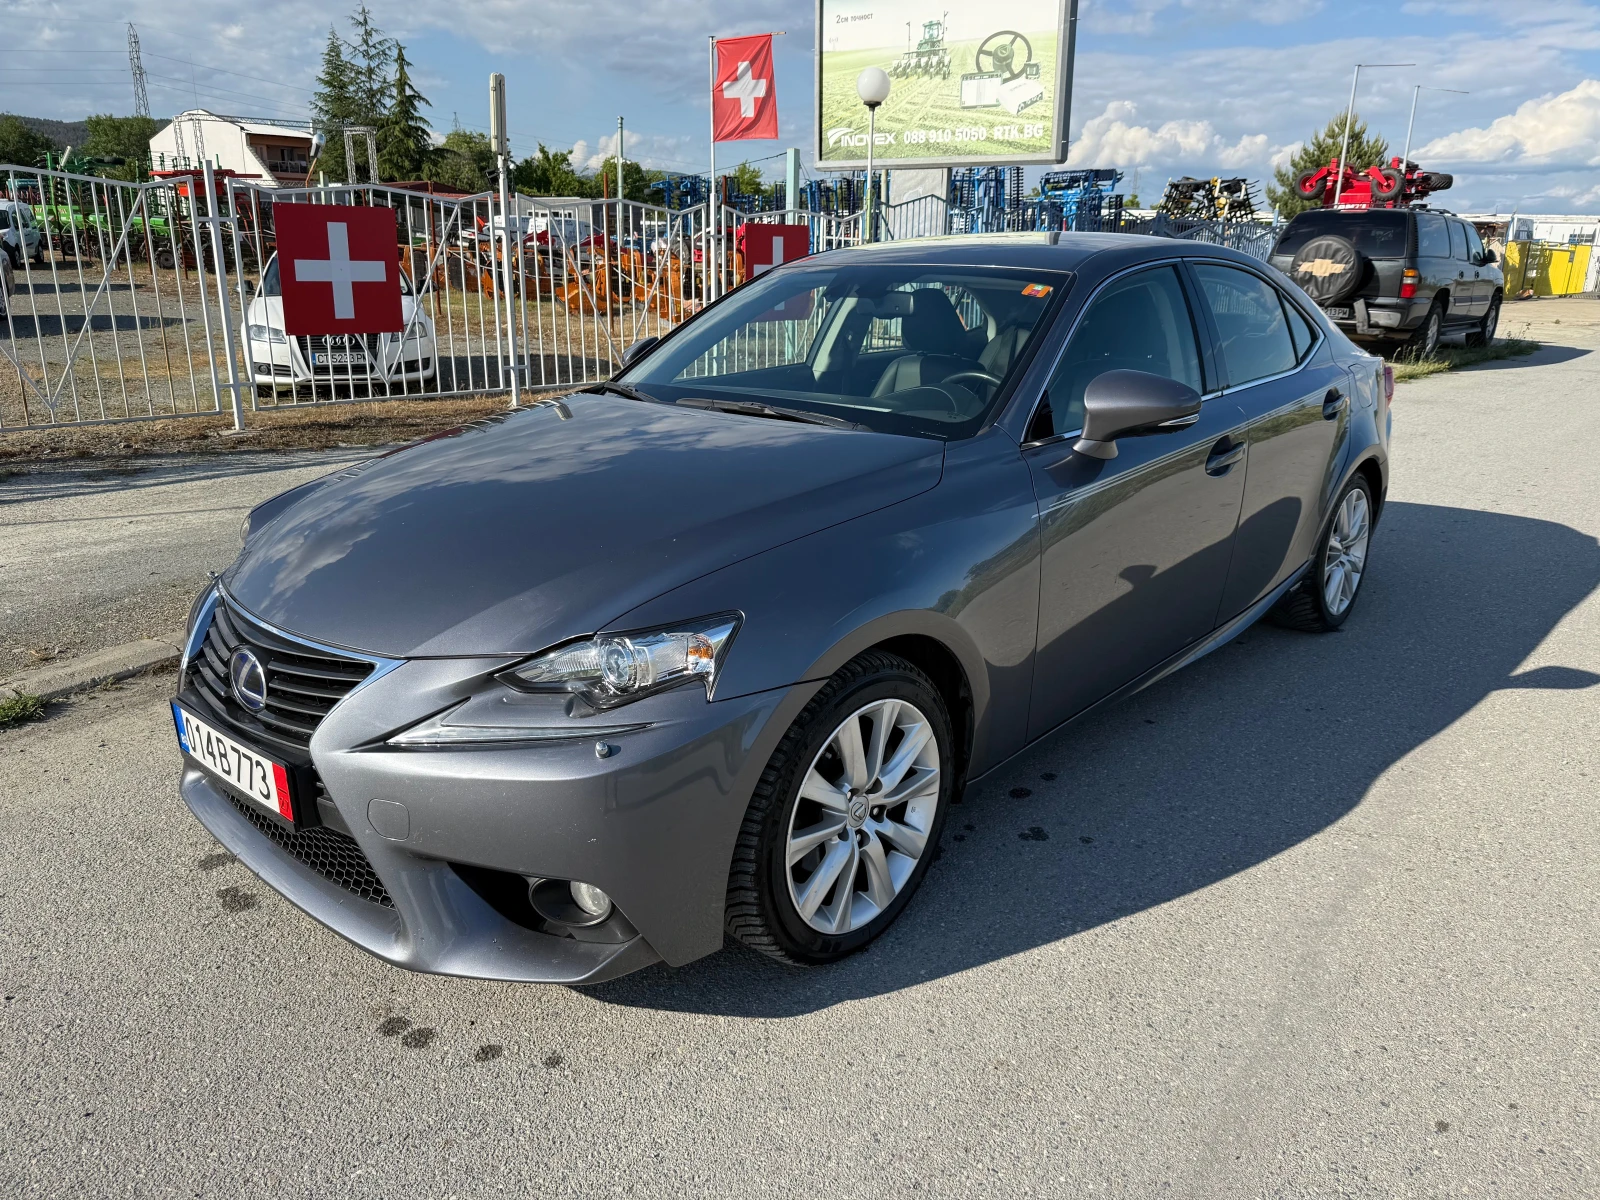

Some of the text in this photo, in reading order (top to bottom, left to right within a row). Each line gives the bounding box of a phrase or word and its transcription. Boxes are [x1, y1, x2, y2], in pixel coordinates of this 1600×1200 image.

[904, 126, 987, 144] 088 910 5050
[993, 123, 1044, 140] RTK.BG
[185, 716, 271, 801] 014B773
